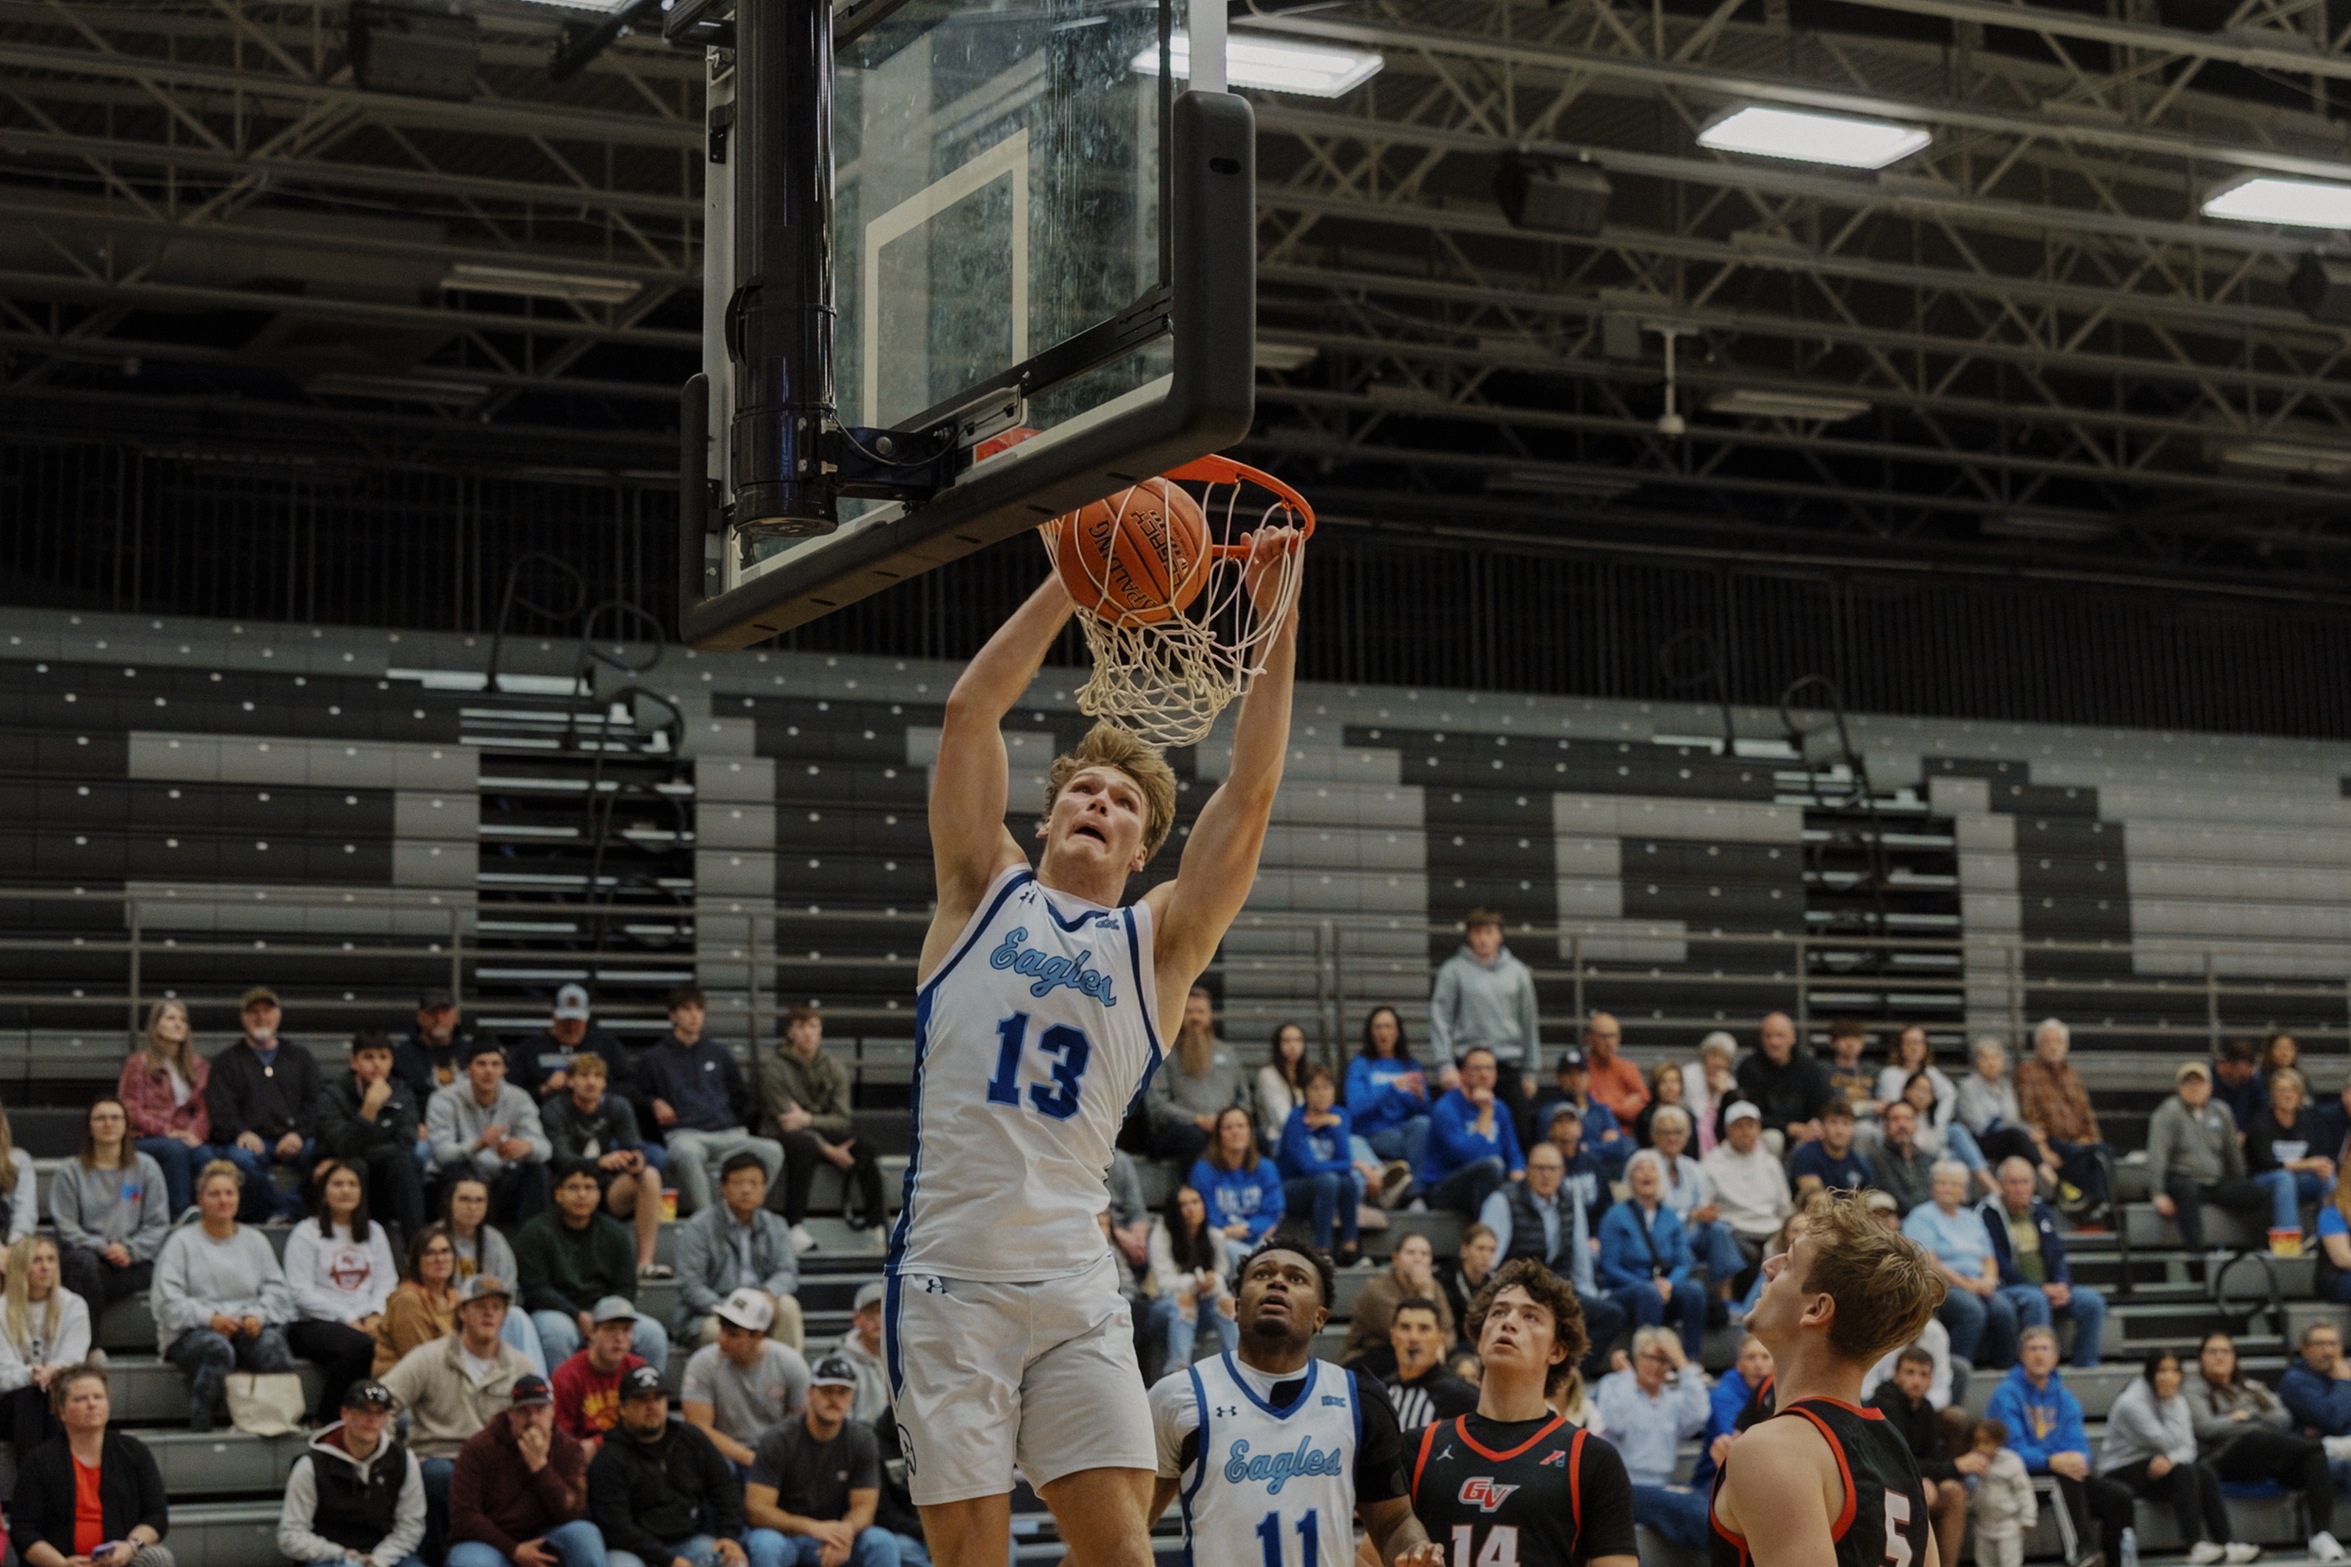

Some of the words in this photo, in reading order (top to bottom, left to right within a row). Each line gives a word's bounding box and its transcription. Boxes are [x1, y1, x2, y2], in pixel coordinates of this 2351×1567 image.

[1089, 519, 1158, 609] SPALDING
[1129, 510, 1182, 588] LEGACY
[989, 926, 1117, 1007] Eagles
[986, 1010, 1091, 1121] 13
[1224, 1435, 1342, 1495] Eagles
[1458, 1476, 1521, 1513] GV
[1255, 1508, 1320, 1567] 11
[1451, 1523, 1521, 1567] 14
[1878, 1487, 1913, 1567] 5
